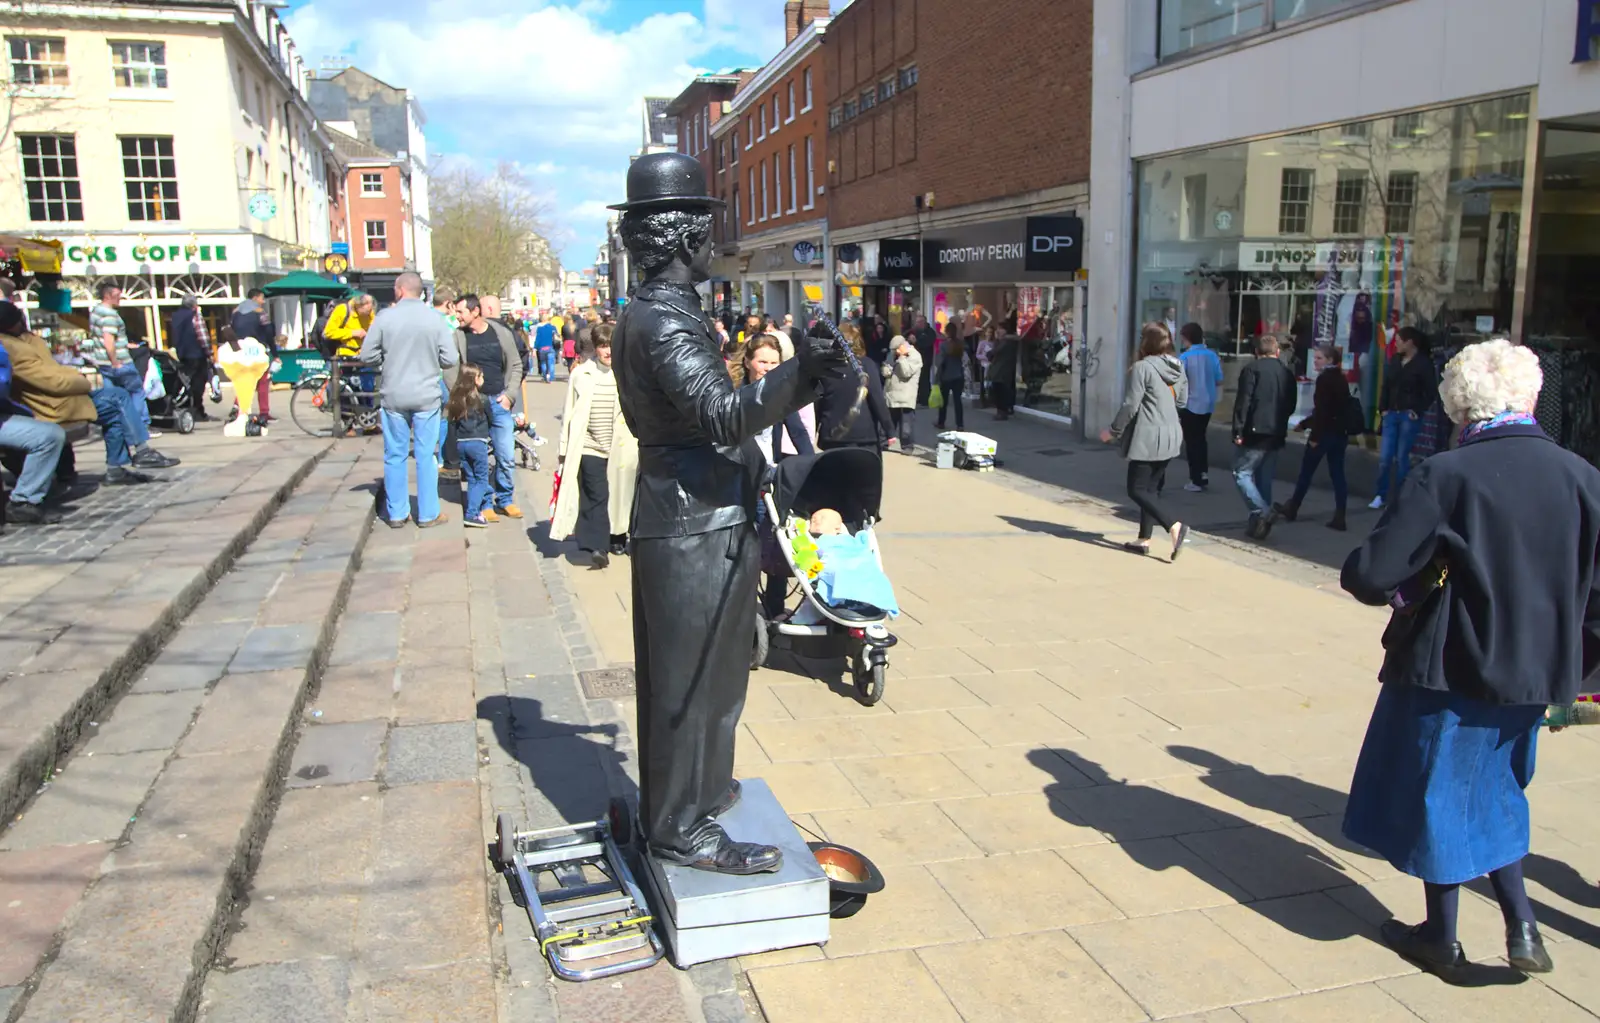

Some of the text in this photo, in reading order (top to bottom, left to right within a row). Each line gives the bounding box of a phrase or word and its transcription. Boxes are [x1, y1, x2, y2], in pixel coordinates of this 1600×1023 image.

[1032, 235, 1073, 252] DP
[132, 245, 227, 262] COFFEE
[939, 242, 1026, 263] DOROTHY PERKI
